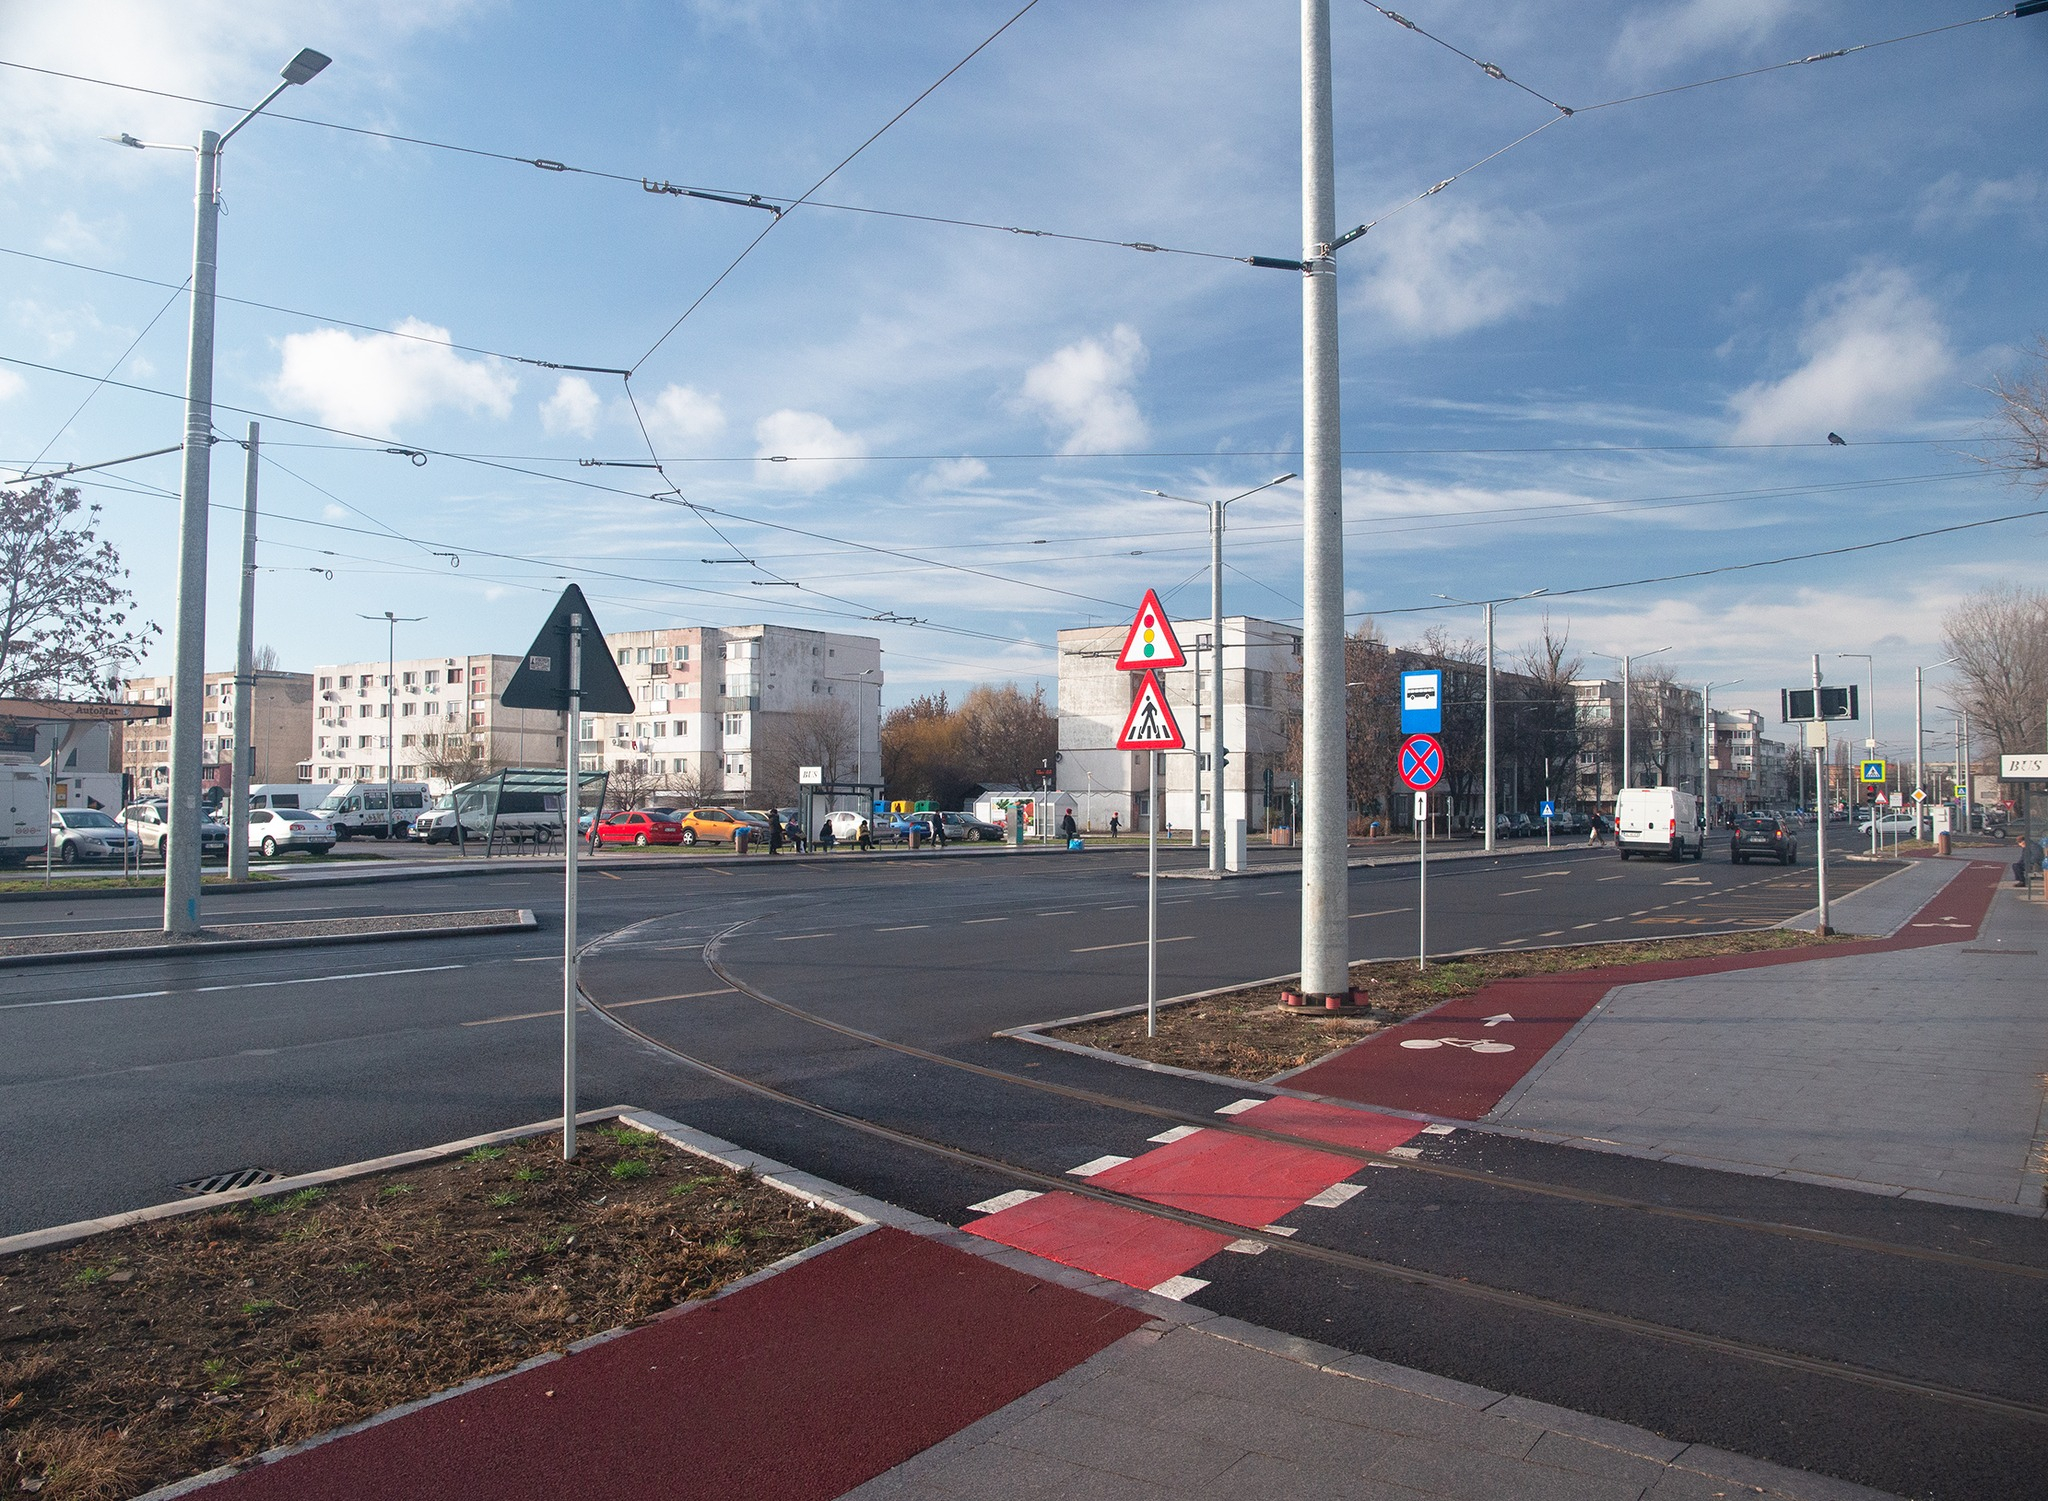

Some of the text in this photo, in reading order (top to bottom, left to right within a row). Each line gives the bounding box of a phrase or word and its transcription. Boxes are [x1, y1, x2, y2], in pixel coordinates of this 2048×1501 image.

[76, 706, 118, 716] AutoMat
[2009, 760, 2042, 772] BUS
[803, 770, 818, 778] BUS
[1630, 917, 1785, 925] BUS
